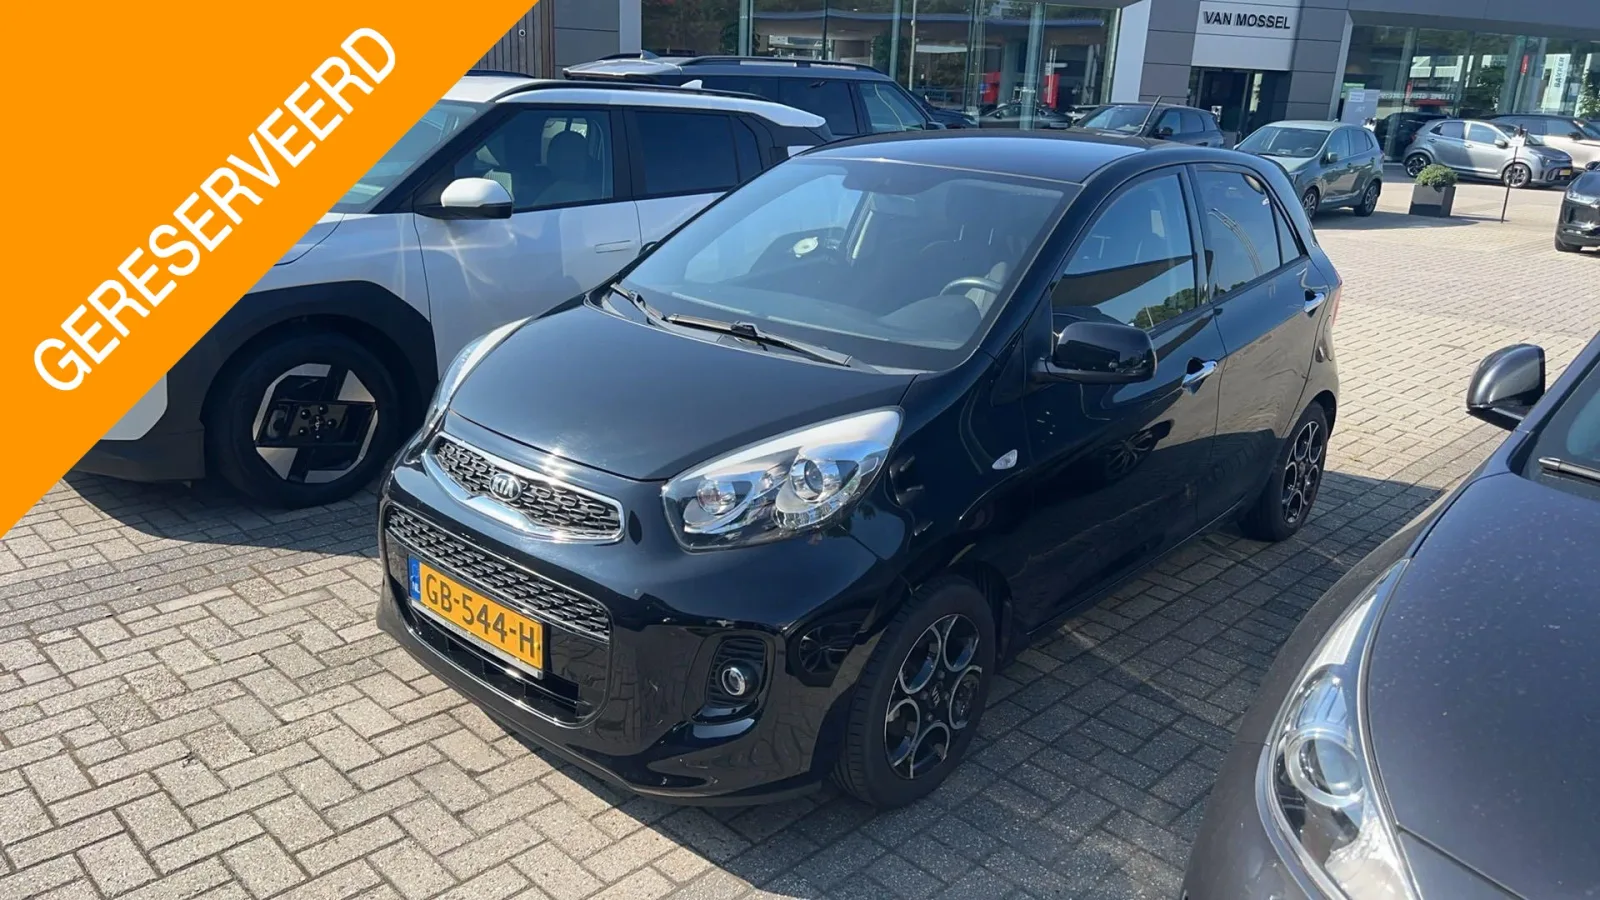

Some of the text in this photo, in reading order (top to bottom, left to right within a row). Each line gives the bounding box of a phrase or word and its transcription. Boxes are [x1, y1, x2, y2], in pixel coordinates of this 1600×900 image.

[1203, 11, 1290, 29] VAN MOSSEL
[492, 476, 514, 498] KIA
[426, 573, 535, 659] GB-544-H
